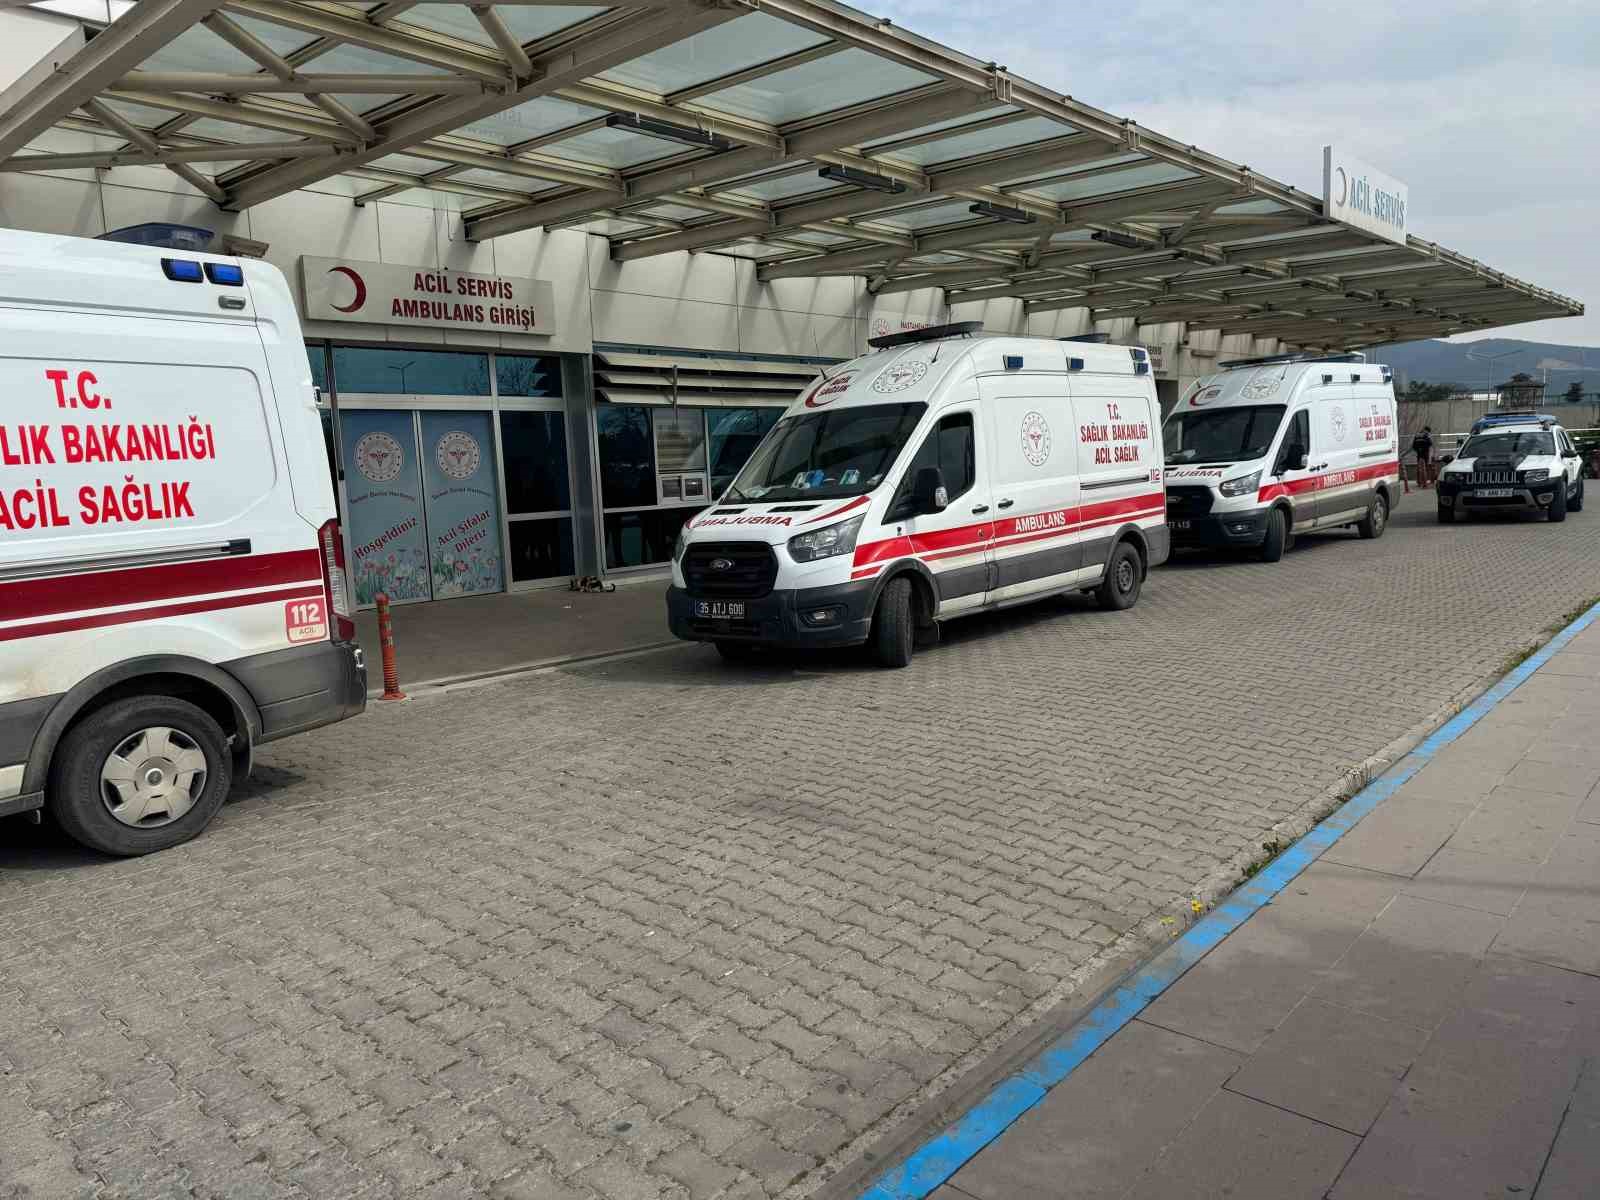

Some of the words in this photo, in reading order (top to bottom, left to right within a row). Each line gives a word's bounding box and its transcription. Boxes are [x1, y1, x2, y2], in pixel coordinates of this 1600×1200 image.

[1350, 176, 1372, 216] ACİL
[1375, 188, 1405, 228] SERVİS
[414, 271, 452, 294] ACİL
[457, 277, 513, 300] SERVİS
[392, 298, 484, 323] AMBULANS
[490, 304, 536, 331] GİRİŞİ
[46, 369, 112, 409] T.C.
[62, 415, 216, 463] BAKANLIĞI
[1081, 422, 1108, 442] SAĞLIK
[1095, 445, 1111, 464] ACİL
[79, 474, 195, 525] SAĞLIK
[1015, 511, 1066, 533] AMBULANS
[291, 603, 321, 625] 112
